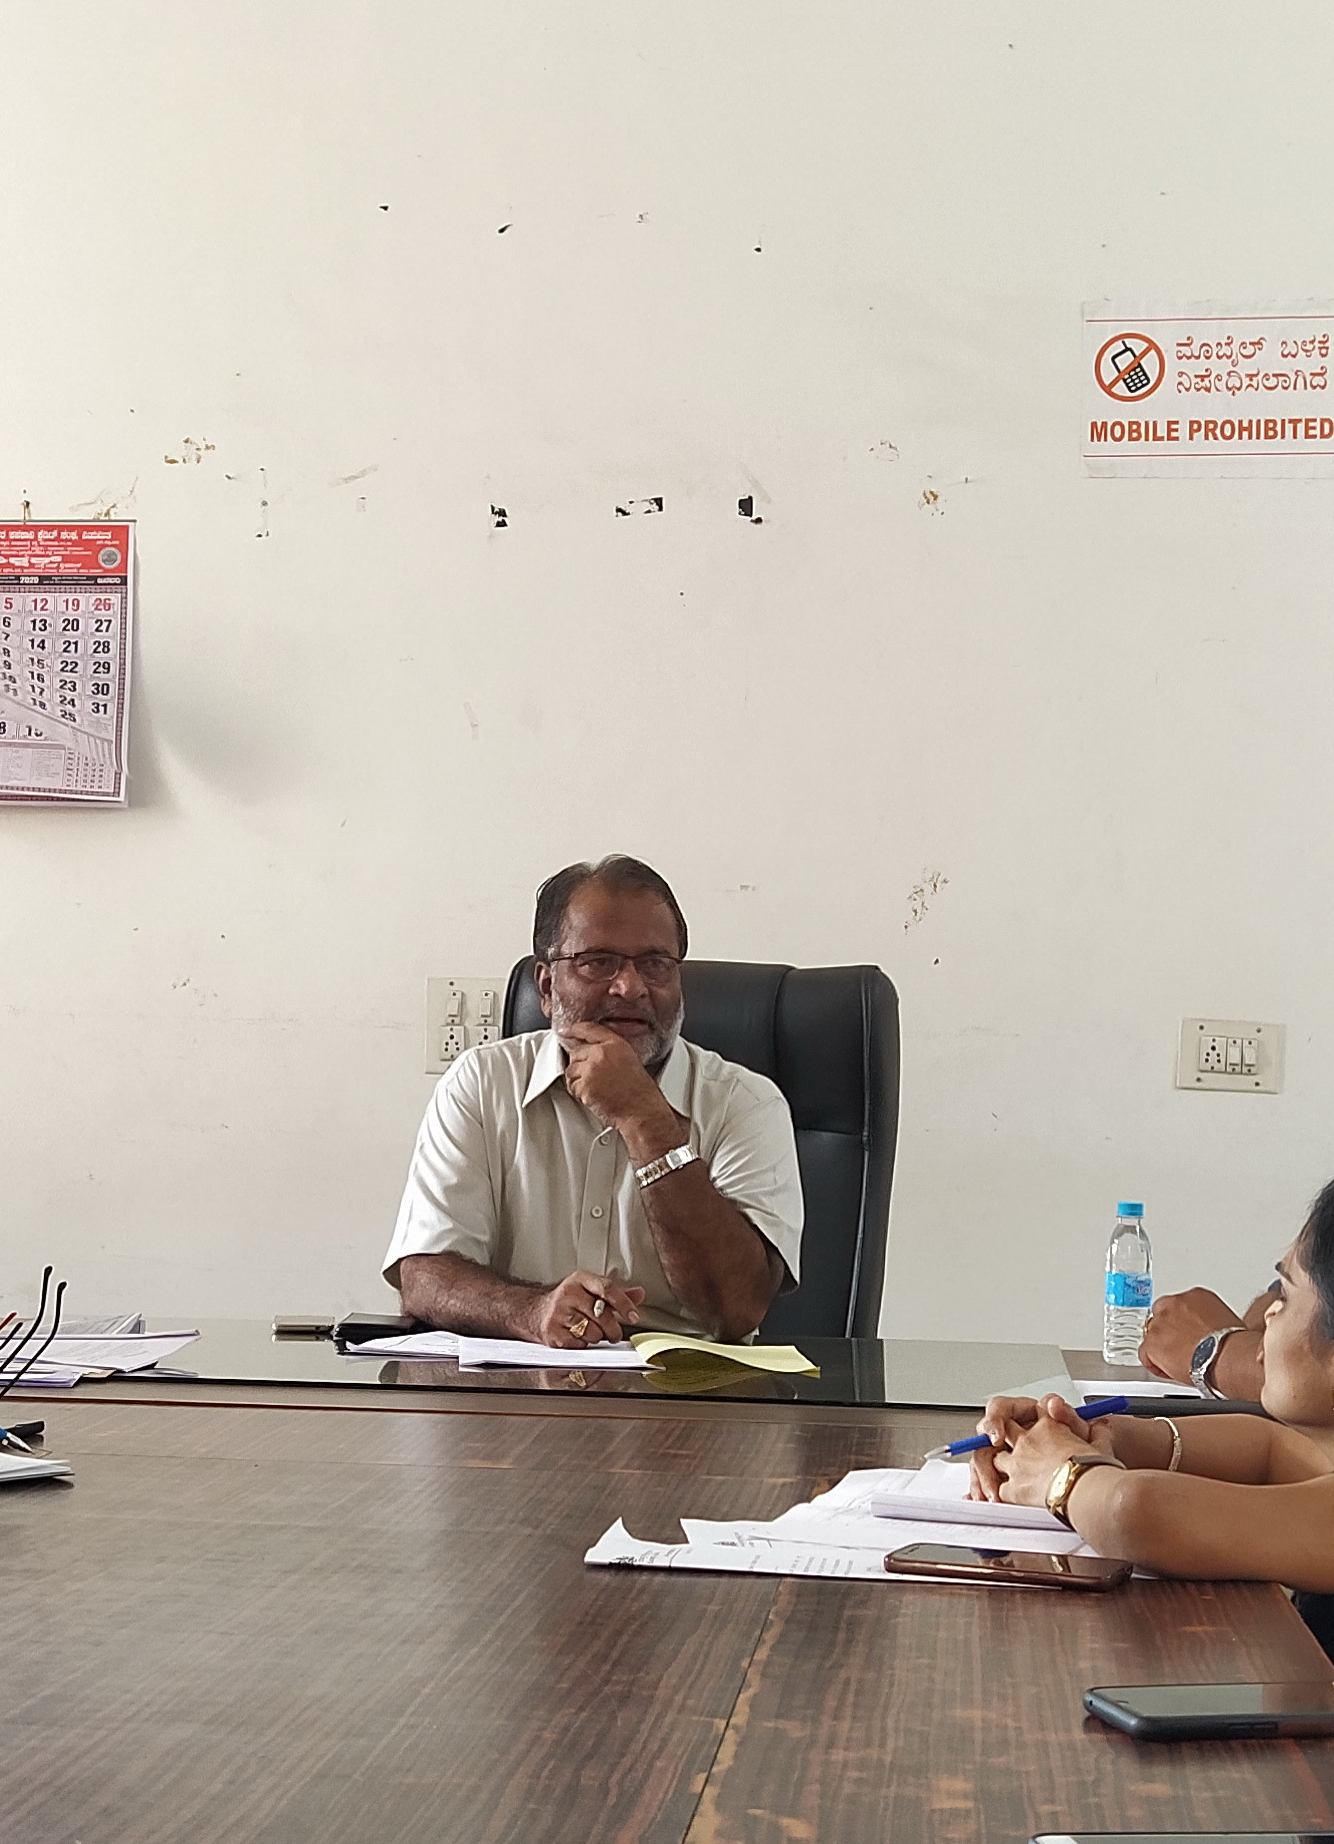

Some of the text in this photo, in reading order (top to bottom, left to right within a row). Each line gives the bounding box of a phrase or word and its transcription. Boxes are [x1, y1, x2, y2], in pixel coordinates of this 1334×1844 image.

[1175, 333, 1331, 367] ಮೊಬೈಲ್ ಬಳಕೆ
[1175, 366, 1328, 397] ನಿಷೇಧಿಸಲಾಗಿದೆ
[1090, 419, 1180, 443] MOBILE
[19, 576, 39, 584] 2020
[3, 597, 112, 612] 5 12 19 26
[2, 616, 113, 633] 6 13 20 27
[2, 632, 11, 642] 7
[28, 638, 46, 651] 14
[62, 640, 79, 654] 21
[93, 640, 111, 654] 28
[2, 647, 11, 658] 8
[28, 657, 45, 670] 15
[59, 660, 79, 674] 22
[92, 661, 111, 674] 29
[3, 660, 12, 671] 9
[28, 671, 45, 683] 16
[58, 679, 77, 692] 23
[91, 683, 110, 696] 30
[29, 684, 45, 696] 17
[58, 694, 77, 708] 24
[91, 702, 108, 715] 31
[59, 709, 77, 723] 25
